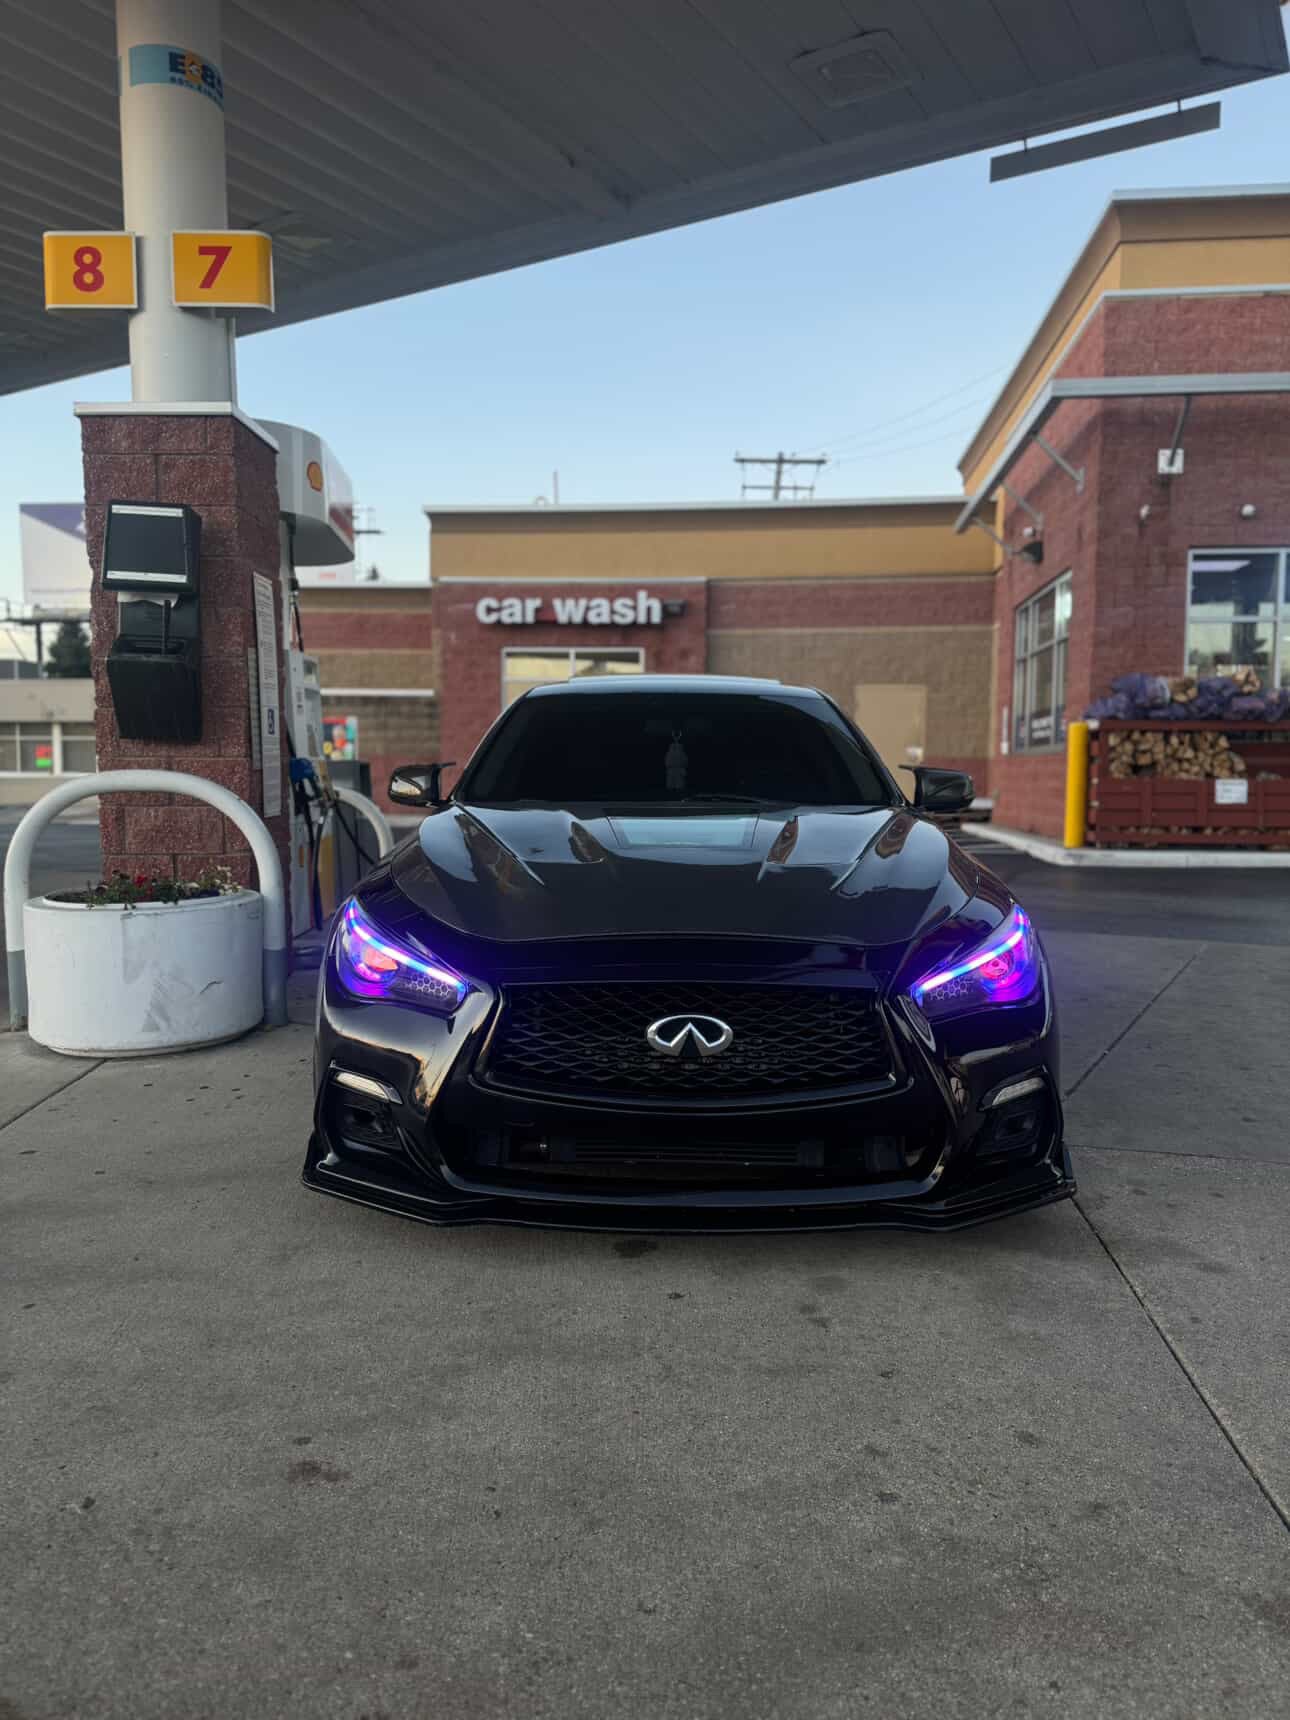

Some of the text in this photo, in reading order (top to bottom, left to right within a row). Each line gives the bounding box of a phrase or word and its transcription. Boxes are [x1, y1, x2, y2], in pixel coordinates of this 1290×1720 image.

[73, 246, 105, 292] 8
[198, 245, 233, 289] 7
[476, 590, 662, 625] car wash
